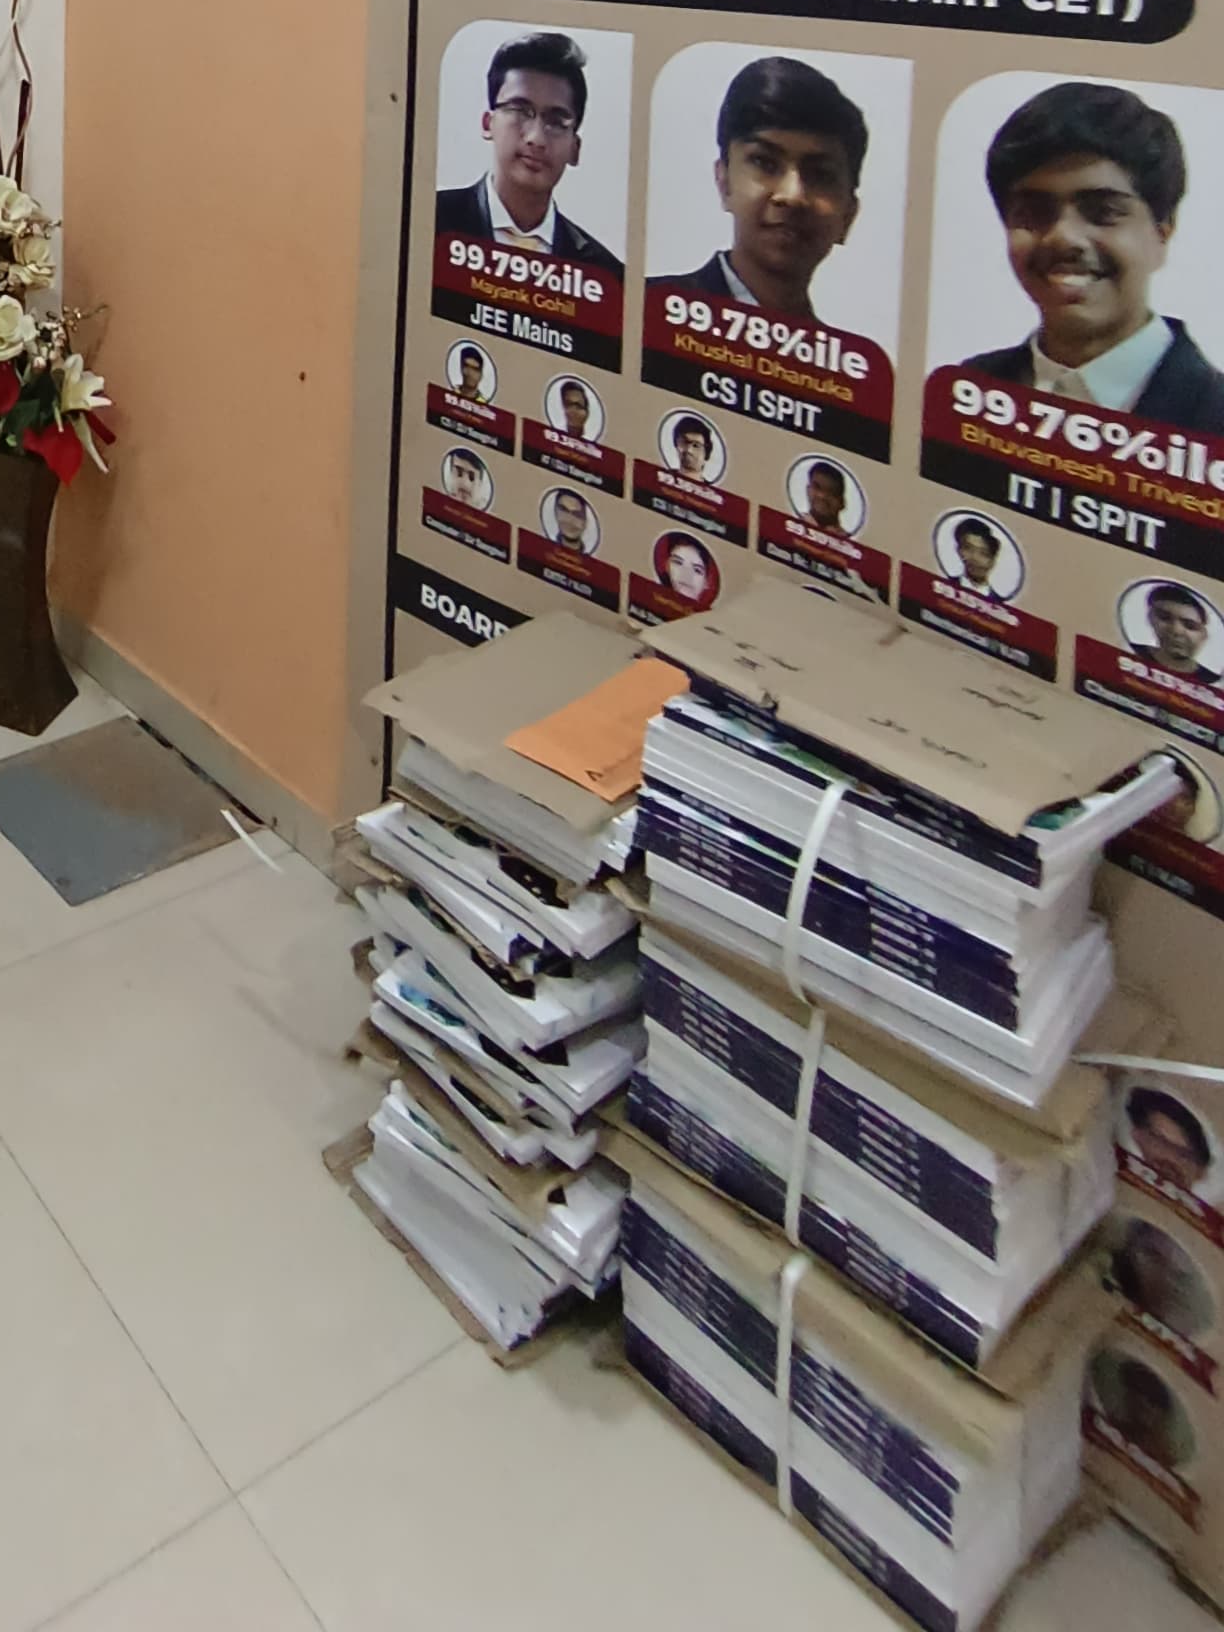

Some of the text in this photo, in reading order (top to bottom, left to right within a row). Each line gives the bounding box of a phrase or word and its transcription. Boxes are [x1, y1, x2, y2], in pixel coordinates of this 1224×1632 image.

[449, 239, 604, 302] 99.79%ile
[471, 276, 530, 305] Mayank
[470, 302, 573, 353] JEE Mains
[665, 294, 869, 379] 99.78%ile
[674, 332, 854, 402] Khushal Dhanuka
[701, 371, 738, 406] CS
[757, 389, 822, 432] SPIT
[961, 423, 1224, 521] Bhuvanesh Trived
[1008, 473, 1044, 509] IT
[1072, 494, 1166, 550] SPIT
